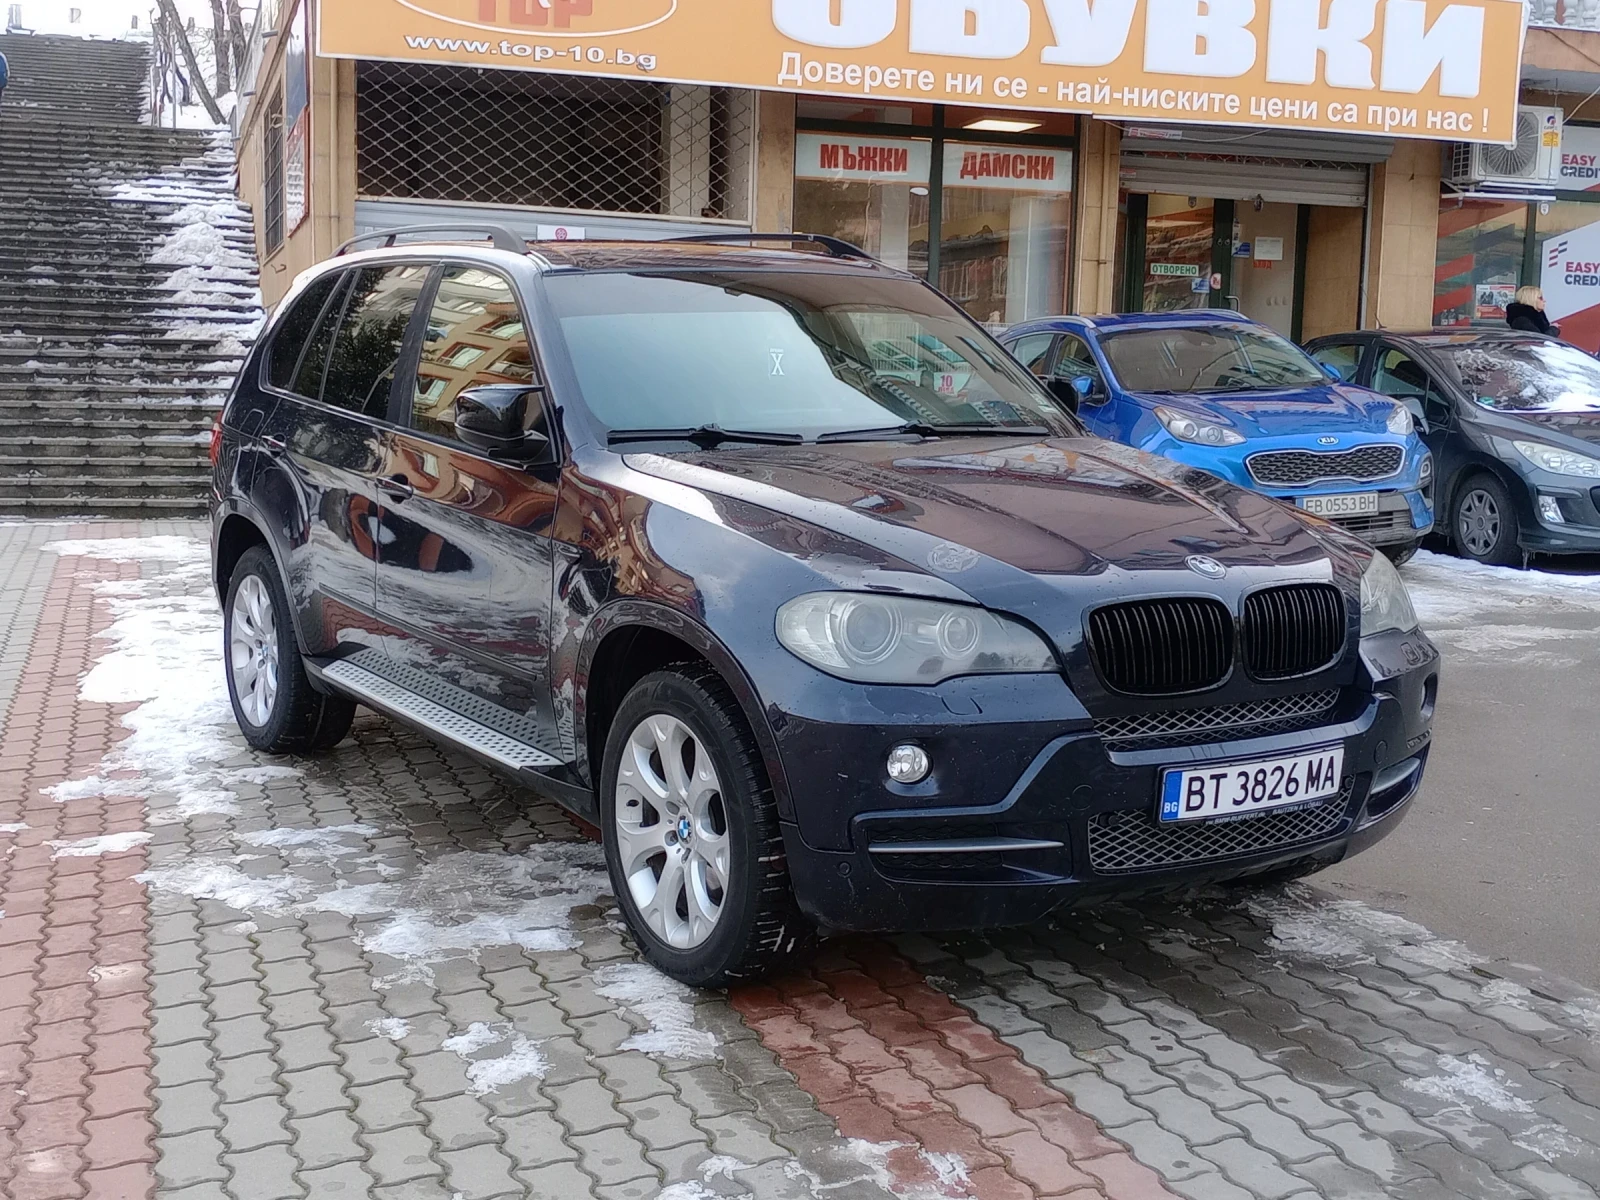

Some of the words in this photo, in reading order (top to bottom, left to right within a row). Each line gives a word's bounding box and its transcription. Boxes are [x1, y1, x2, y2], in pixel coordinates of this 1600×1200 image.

[404, 35, 657, 71] www.top-10.bg
[777, 51, 935, 93] Доверете
[945, 72, 983, 96] ни
[993, 76, 1028, 98] се
[1057, 78, 1240, 114] най-ниските
[1250, 95, 1318, 121] цени
[1326, 102, 1358, 124] са
[1367, 104, 1418, 132] при
[1426, 108, 1473, 132] нас
[820, 143, 908, 172] МЪЖКИ
[1561, 154, 1597, 166] EASY
[960, 151, 1056, 181] ДАМСКИ
[1152, 264, 1198, 275] ОТВОРЕНО
[1565, 261, 1600, 274] EASY
[1564, 274, 1600, 286] CRED
[940, 375, 953, 387] 10
[1326, 497, 1357, 512] 0553
[1360, 495, 1376, 510] BH
[1185, 773, 1228, 812] BT
[1232, 762, 1299, 806] 3826
[1304, 755, 1335, 794] MA
[1163, 801, 1178, 813] BG
